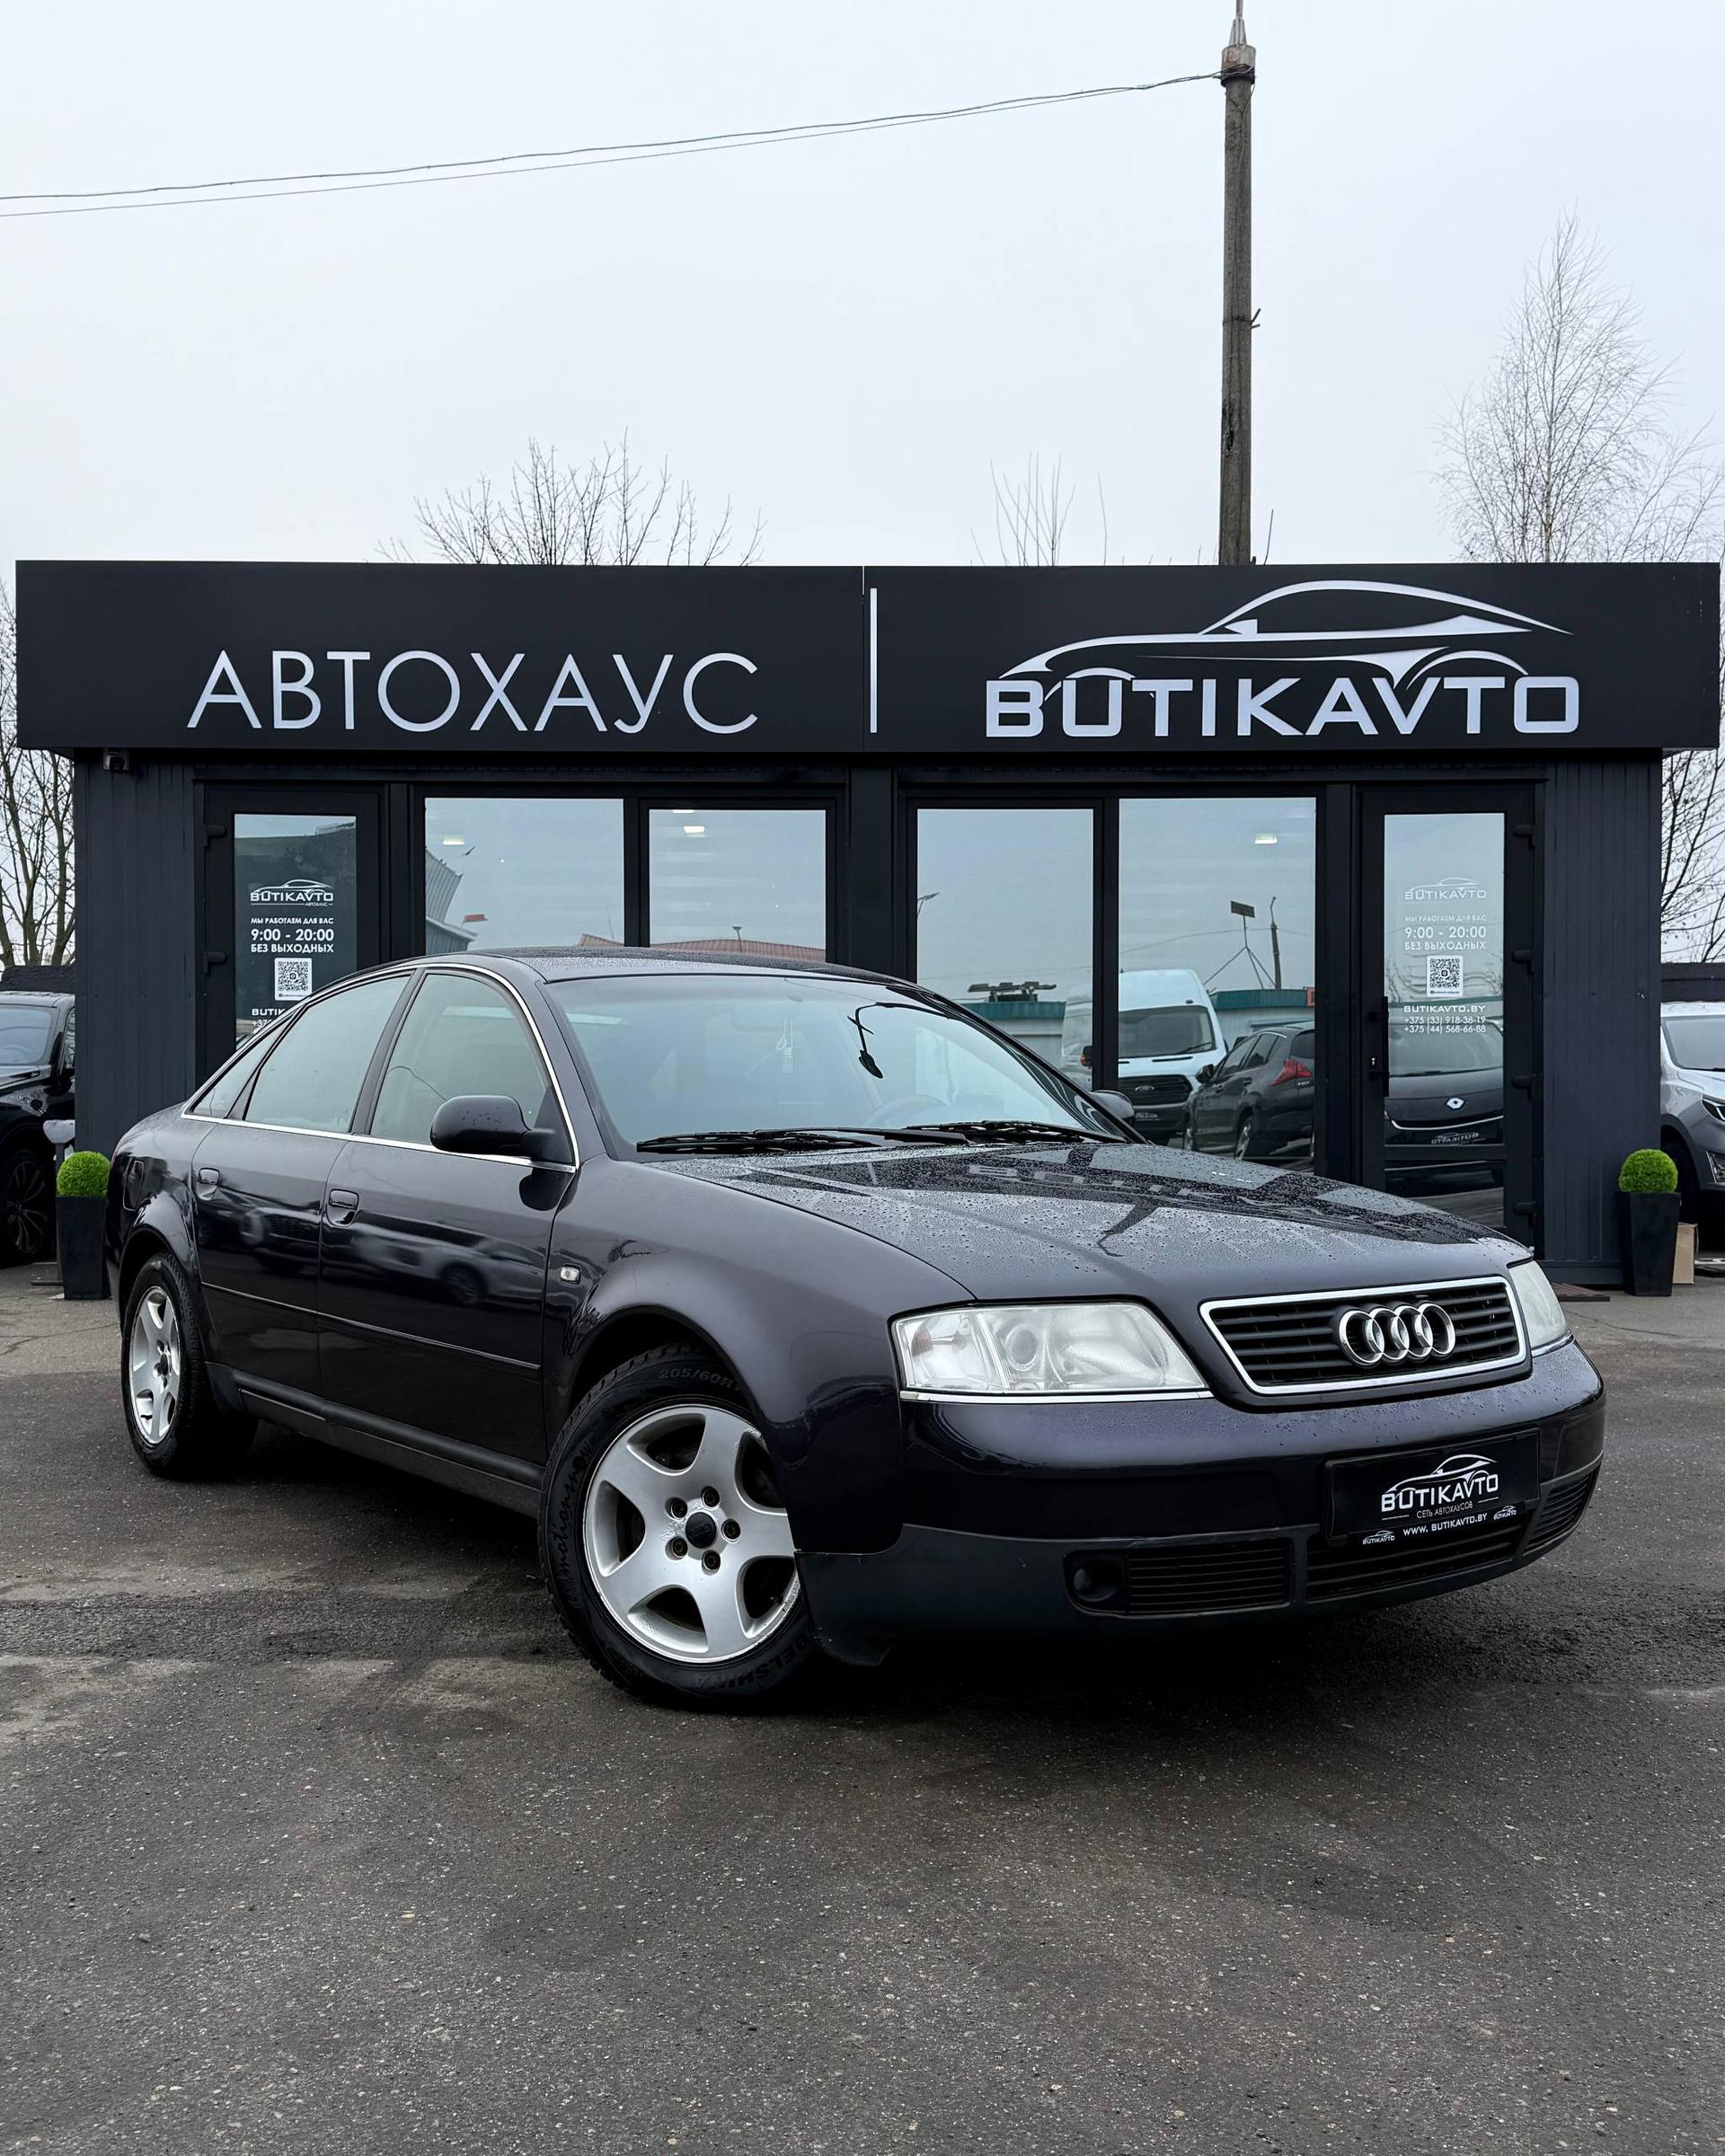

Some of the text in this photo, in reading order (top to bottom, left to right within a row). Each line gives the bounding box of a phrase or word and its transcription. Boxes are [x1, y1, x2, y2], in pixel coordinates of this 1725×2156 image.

[187, 650, 758, 734] АВТОХАУС
[986, 676, 1580, 738] BUTIKAVTO
[251, 892, 333, 901] BUTIKAVTO
[1404, 890, 1486, 900] BUTIKAVTO
[252, 928, 281, 941] 9:00
[295, 928, 334, 941] 20:00
[1405, 926, 1434, 939] 9:00
[1448, 925, 1487, 939] 20:00
[251, 943, 334, 953] БЕЗ ВЫХОДНЫХ
[1404, 941, 1486, 950] БЕЗ ВЫХОДНЫХ
[1404, 1015, 1486, 1026] +375 (33) 918-38-19
[1404, 1025, 1486, 1034] +375 (44) 568-66-88
[1381, 1473, 1499, 1513] BUTIKAVTO
[1416, 1501, 1473, 1519] СЕТЬ АВТОХАУСОВ
[1402, 1512, 1488, 1536] WWW. BUTIKAVTO.BY
